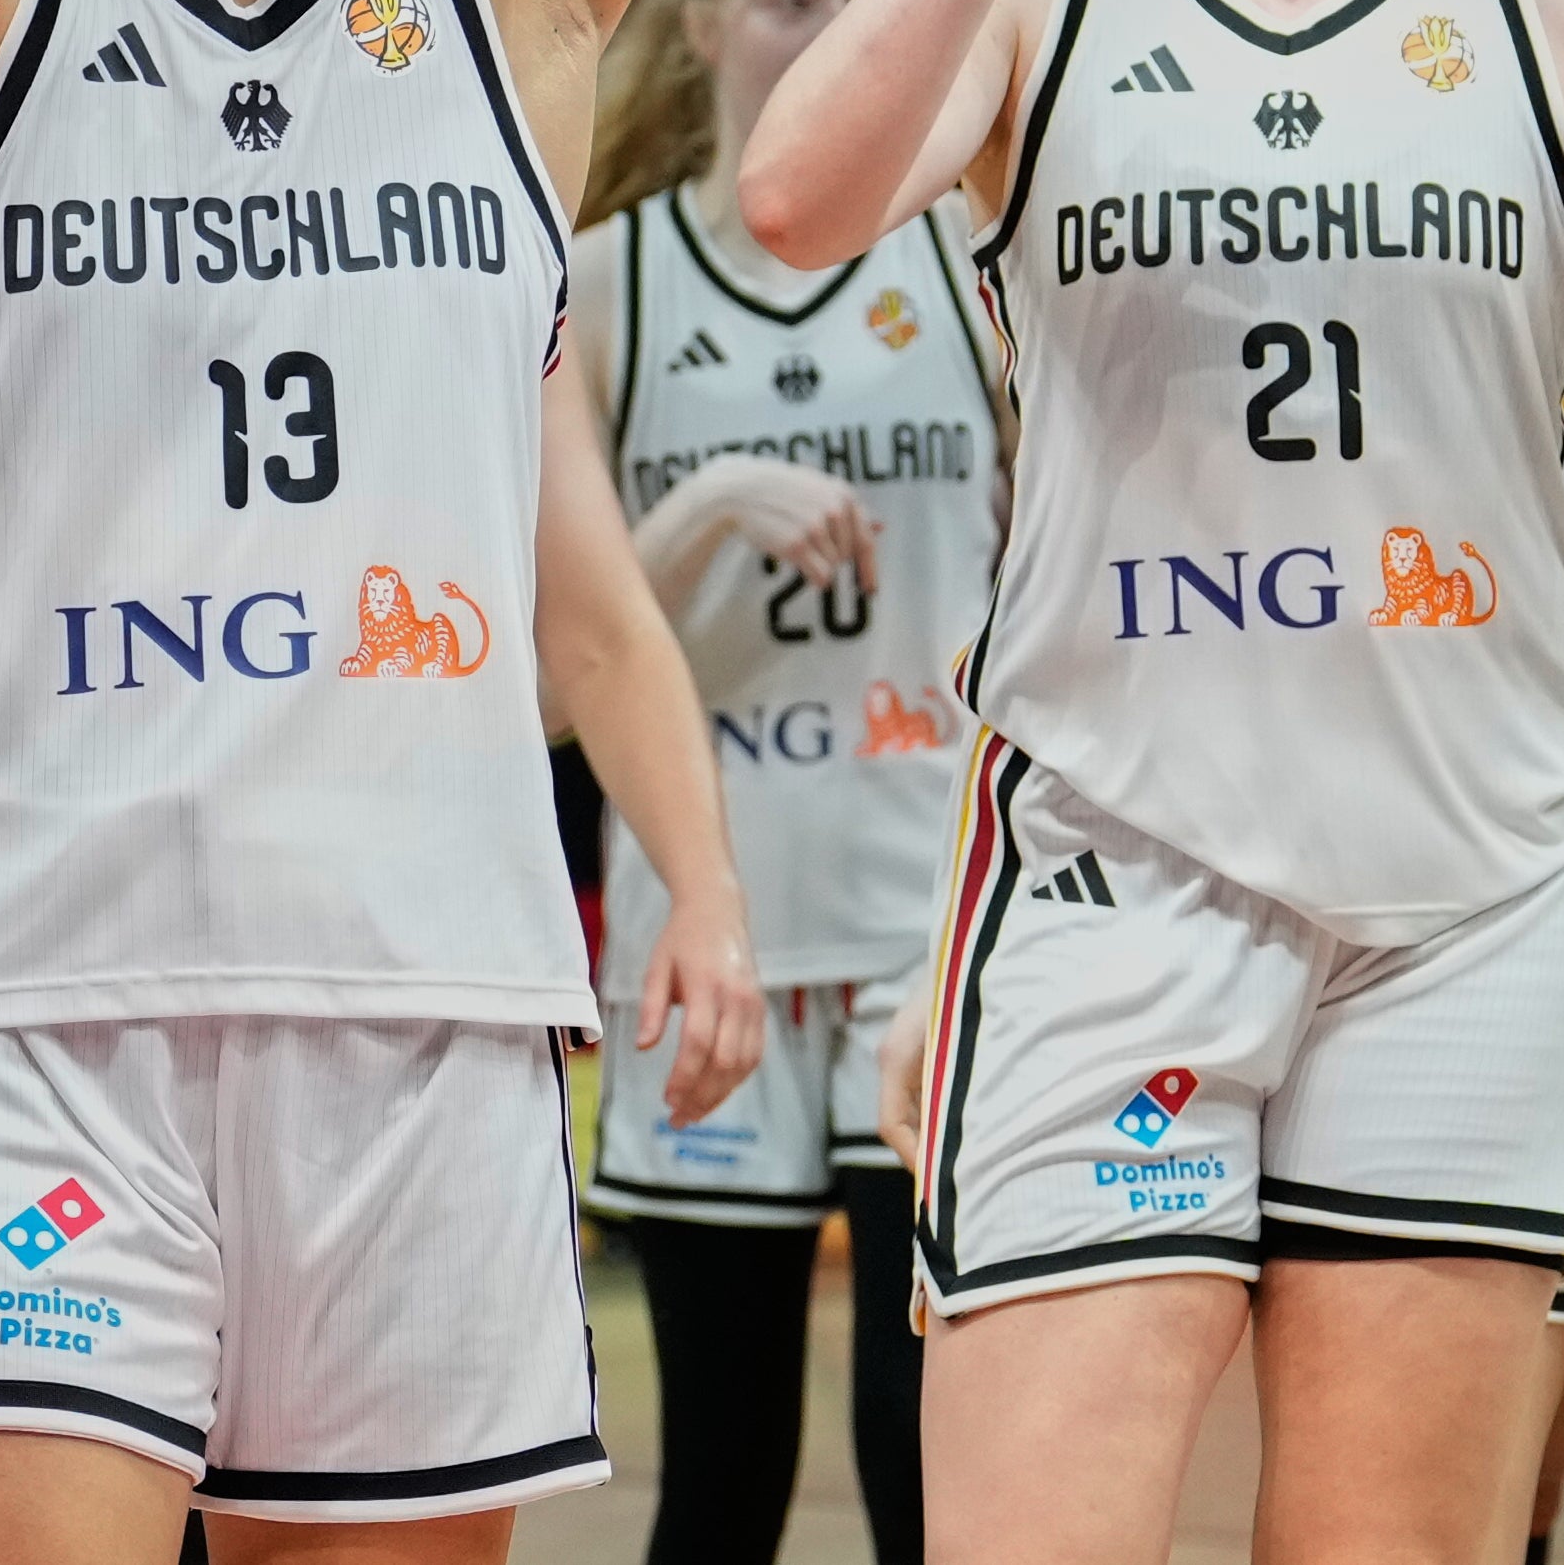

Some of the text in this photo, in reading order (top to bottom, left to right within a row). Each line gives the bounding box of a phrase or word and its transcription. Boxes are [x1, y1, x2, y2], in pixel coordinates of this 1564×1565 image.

[4, 182, 506, 294] DEUTSCHLAND
[1057, 182, 1524, 286] DEUTSCHLAND
[208, 351, 339, 509] 13
[1242, 319, 1363, 462] 21
[55, 590, 318, 695] ING
[1109, 547, 1344, 640] ING
[709, 700, 833, 766] NG
[1094, 1154, 1225, 1187] Domino's
[1129, 1188, 1207, 1213] Pizza
[0, 1317, 92, 1355] Pizza
